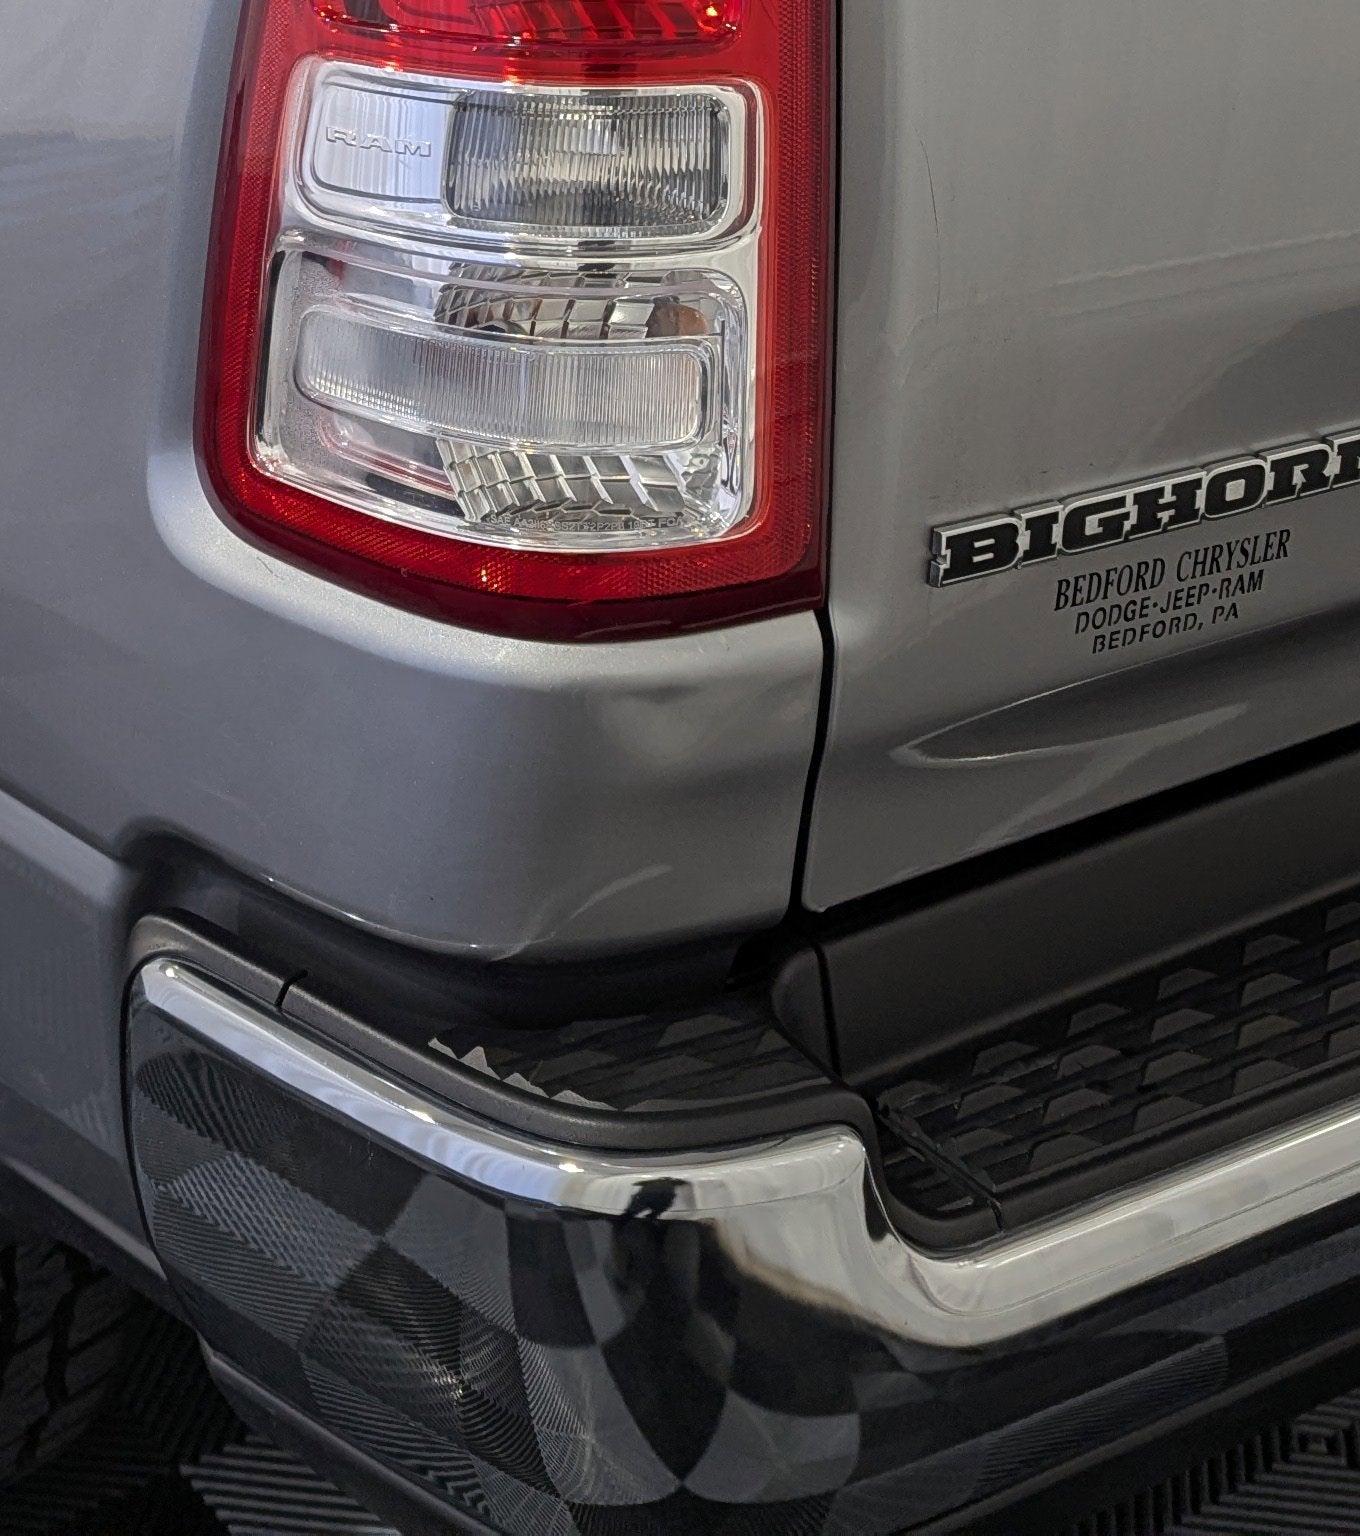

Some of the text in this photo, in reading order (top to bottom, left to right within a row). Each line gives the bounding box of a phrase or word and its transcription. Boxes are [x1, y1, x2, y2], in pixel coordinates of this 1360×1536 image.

[325, 125, 432, 158] RAM
[1053, 527, 1292, 613] BEDFORD CHRYSLER
[1091, 601, 1240, 655] BEDFORD, PA
